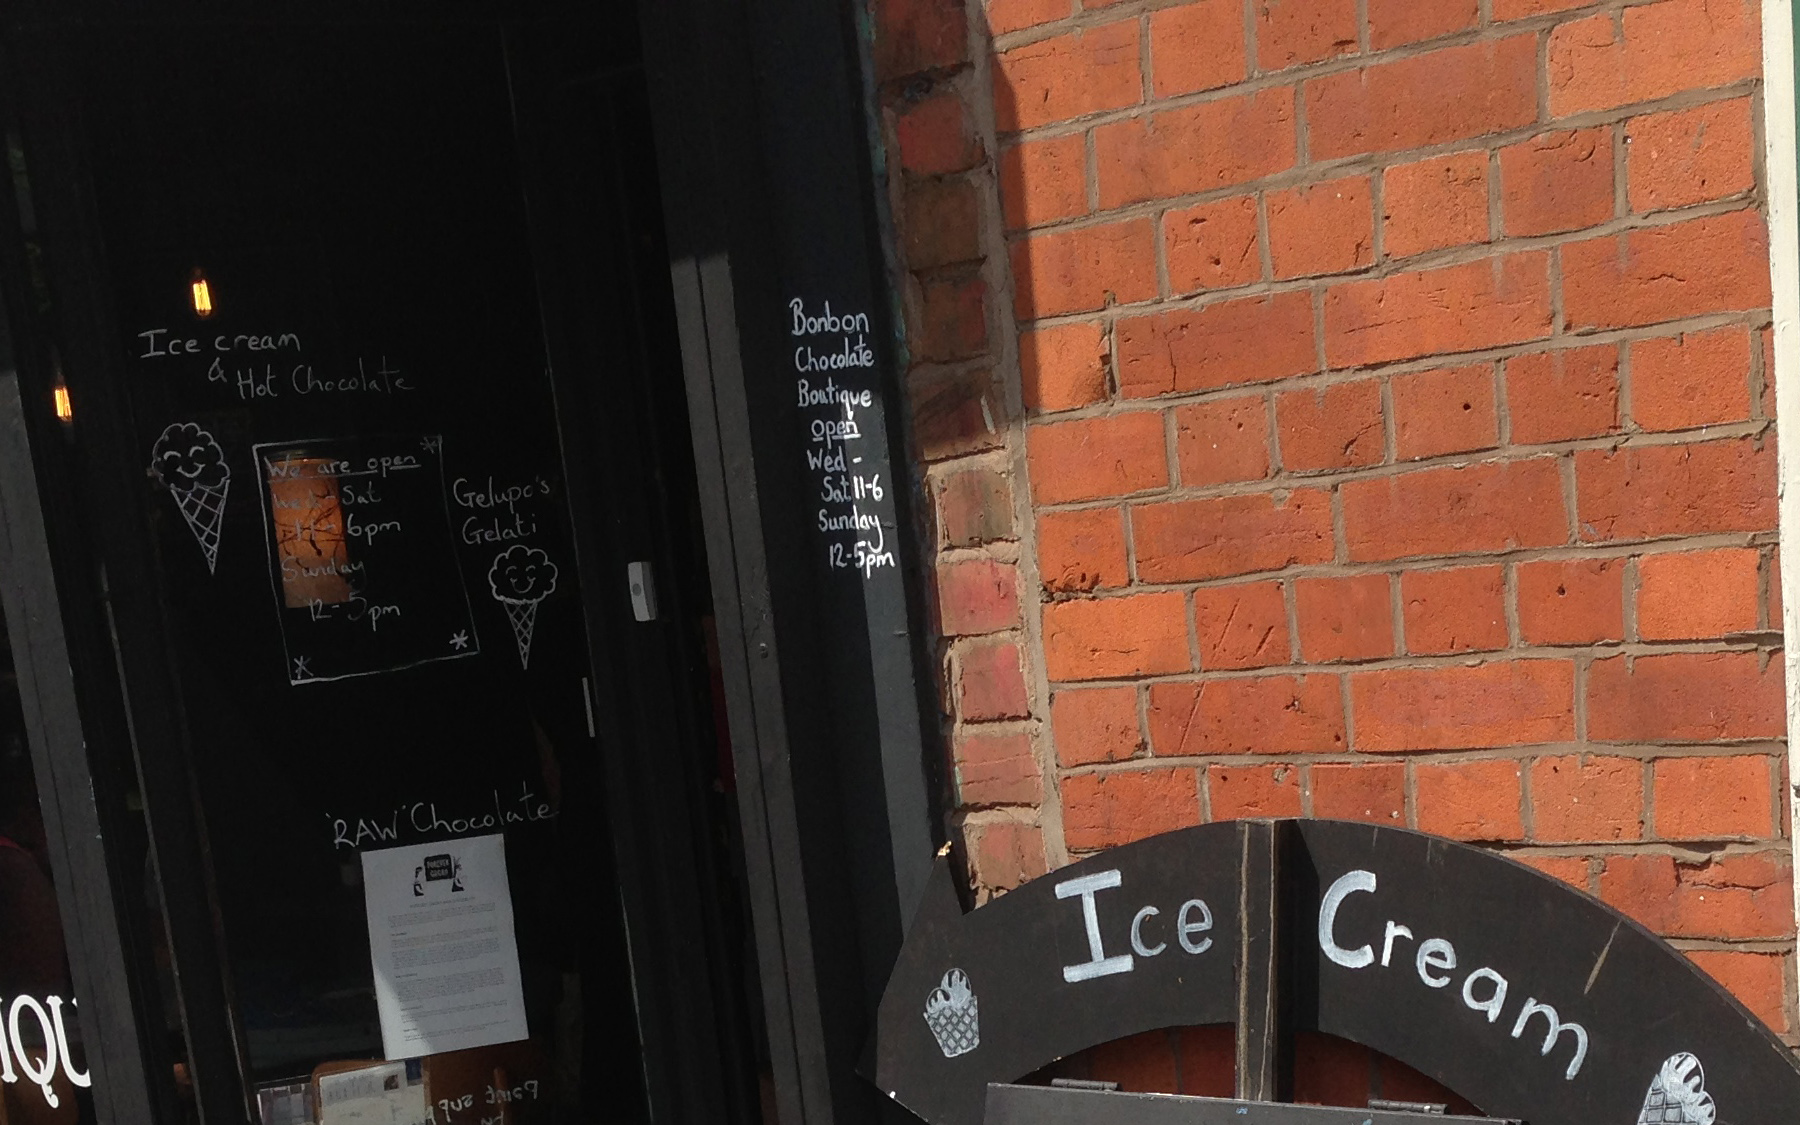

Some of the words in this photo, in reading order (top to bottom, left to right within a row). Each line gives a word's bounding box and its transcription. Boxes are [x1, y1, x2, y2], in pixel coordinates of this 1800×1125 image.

[789, 297, 870, 336] Bonbon
[138, 328, 200, 359] Ice
[215, 332, 301, 352] cream
[795, 334, 875, 373] Chocolate
[236, 365, 279, 400] Hot
[291, 356, 415, 394] Chocolate
[798, 378, 872, 420] Boutique
[811, 418, 861, 449] open
[265, 453, 300, 478] We
[317, 459, 351, 474] are
[366, 455, 417, 478] open
[821, 475, 851, 503] Sat
[853, 473, 884, 502] 11-6
[461, 513, 539, 546] Gelati
[818, 505, 884, 554] Sunday
[281, 558, 367, 585] Sunday
[829, 540, 895, 579] 12-5pm
[410, 780, 559, 833] Chocolate
[1054, 869, 1214, 983] Ice
[1318, 869, 1590, 1081] Cream
